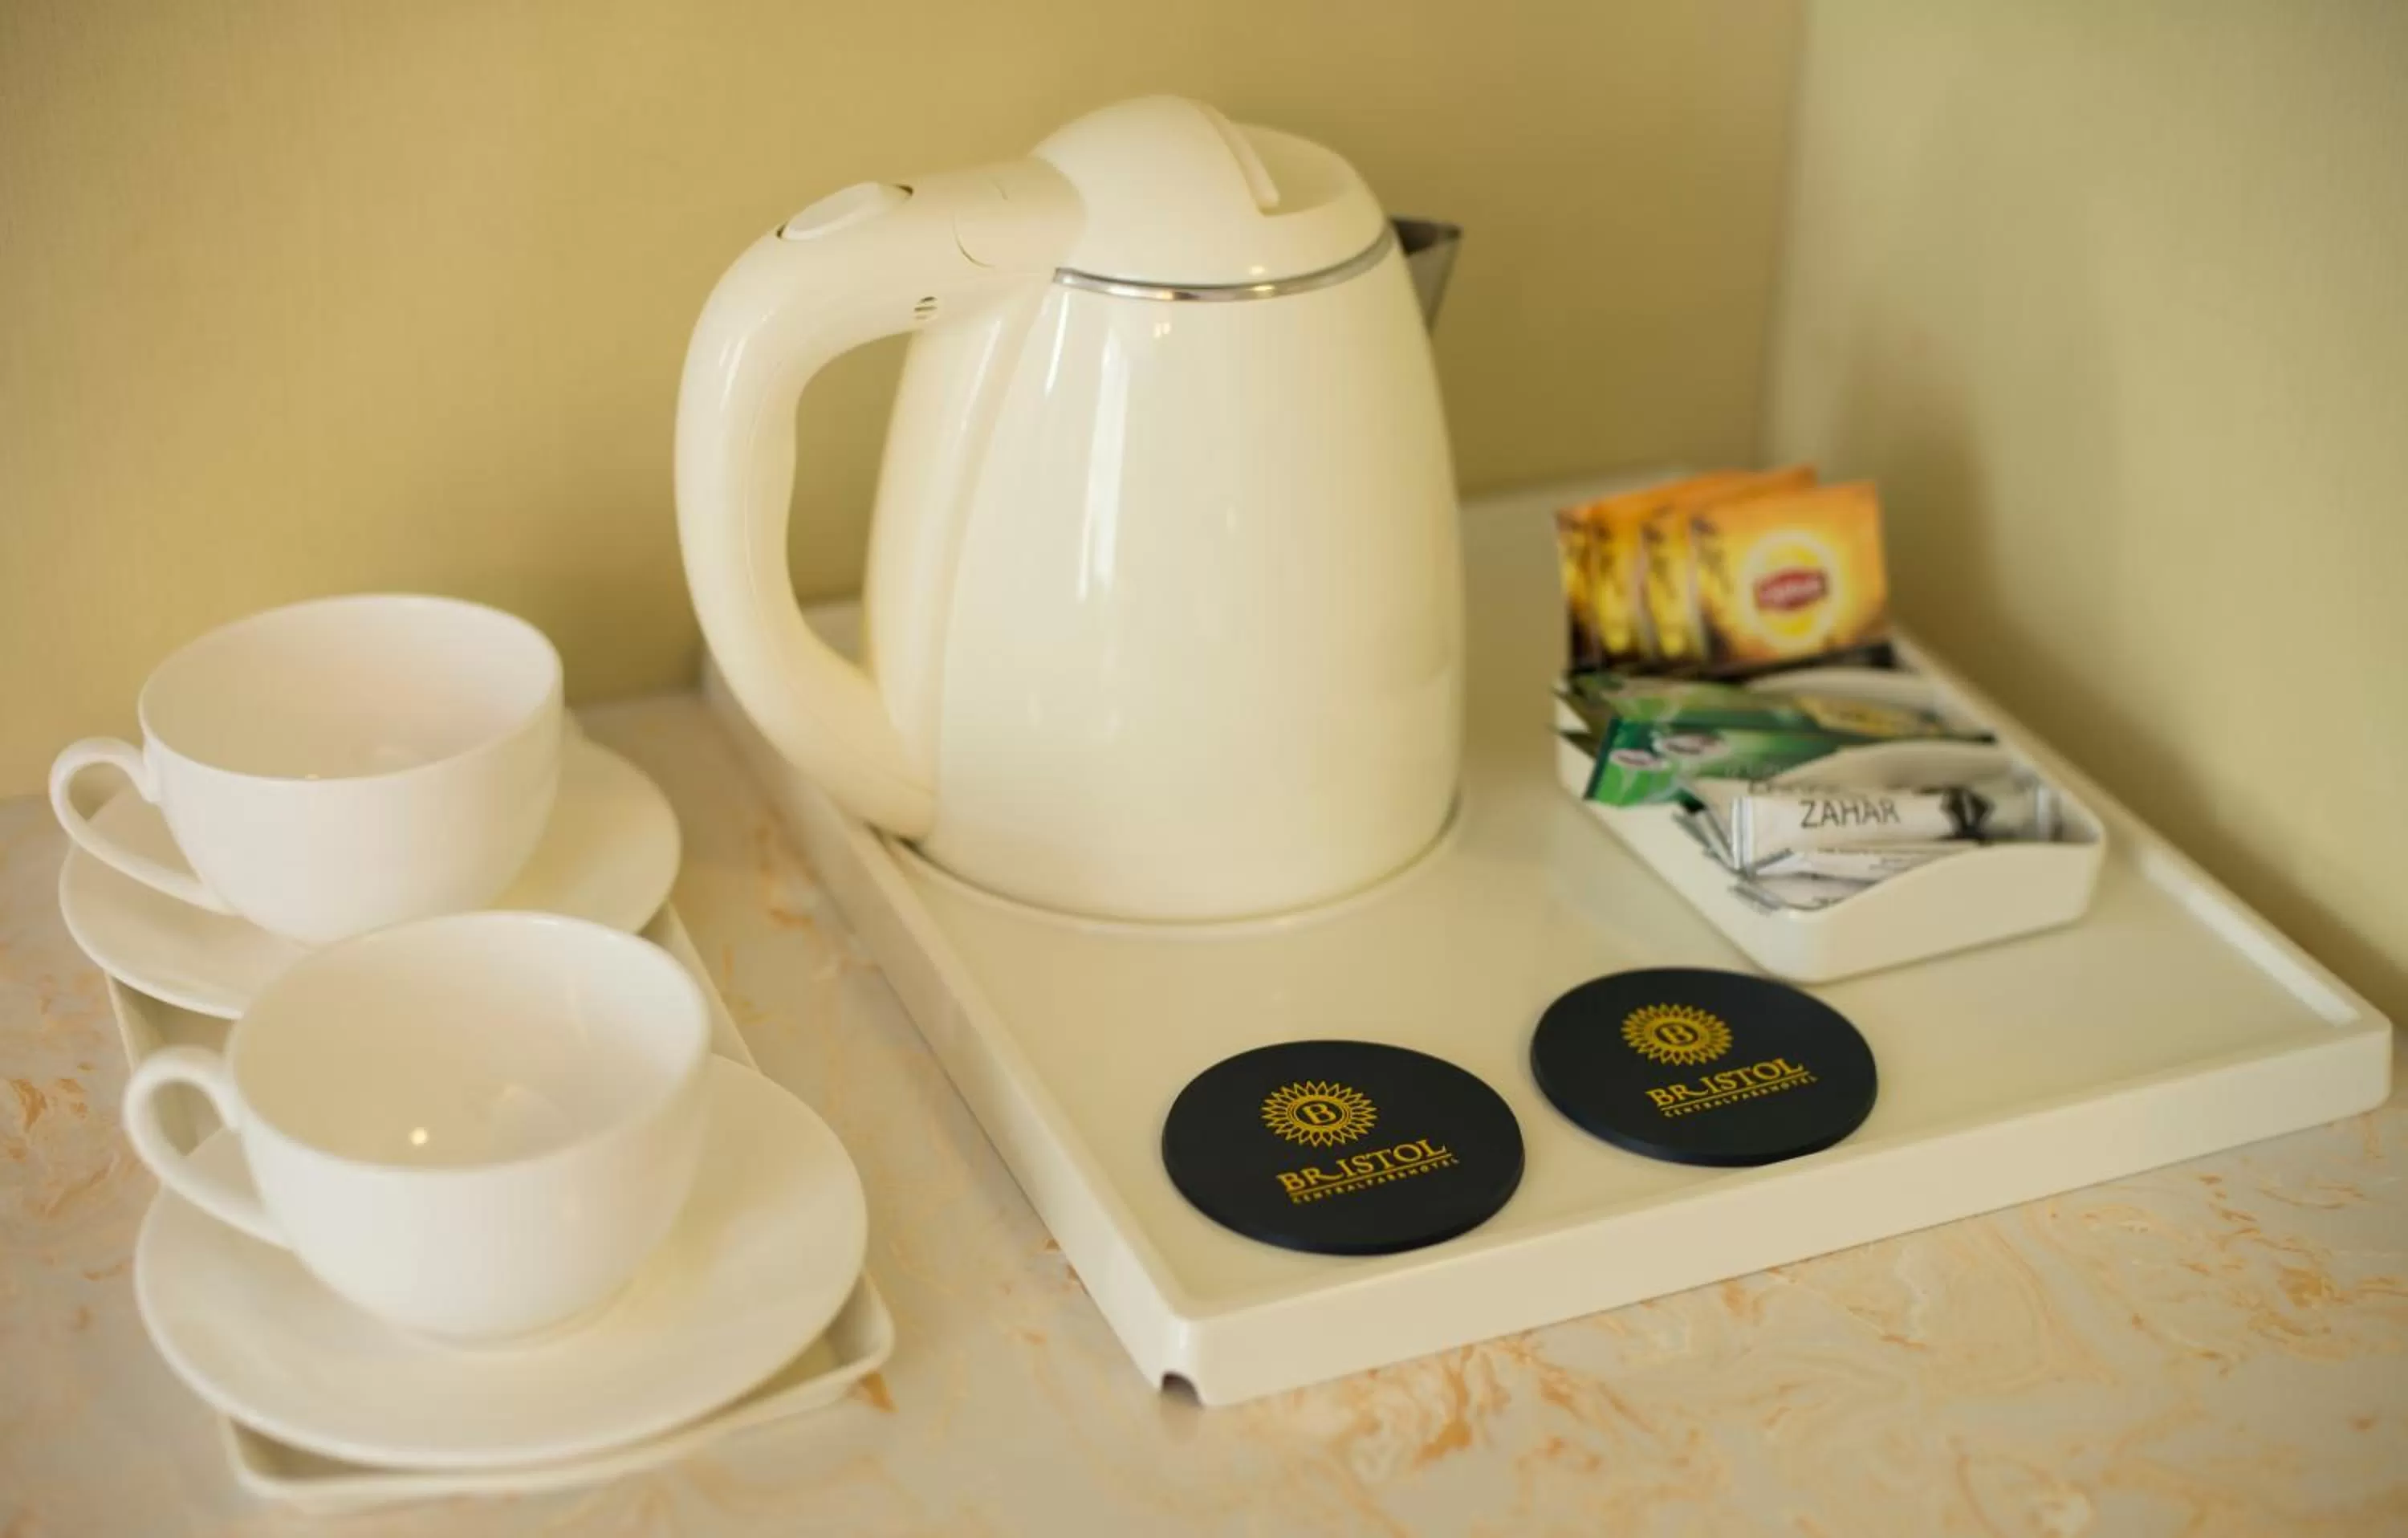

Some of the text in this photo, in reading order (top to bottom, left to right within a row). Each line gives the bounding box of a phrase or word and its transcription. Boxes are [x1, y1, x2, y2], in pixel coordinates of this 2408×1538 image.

[1799, 797, 1901, 829] ZAHAR
[1660, 1025, 1694, 1045] B
[1645, 1058, 1804, 1108] BRISTOL
[1302, 1103, 1337, 1125] B
[1276, 1139, 1446, 1191] BRISTOL
